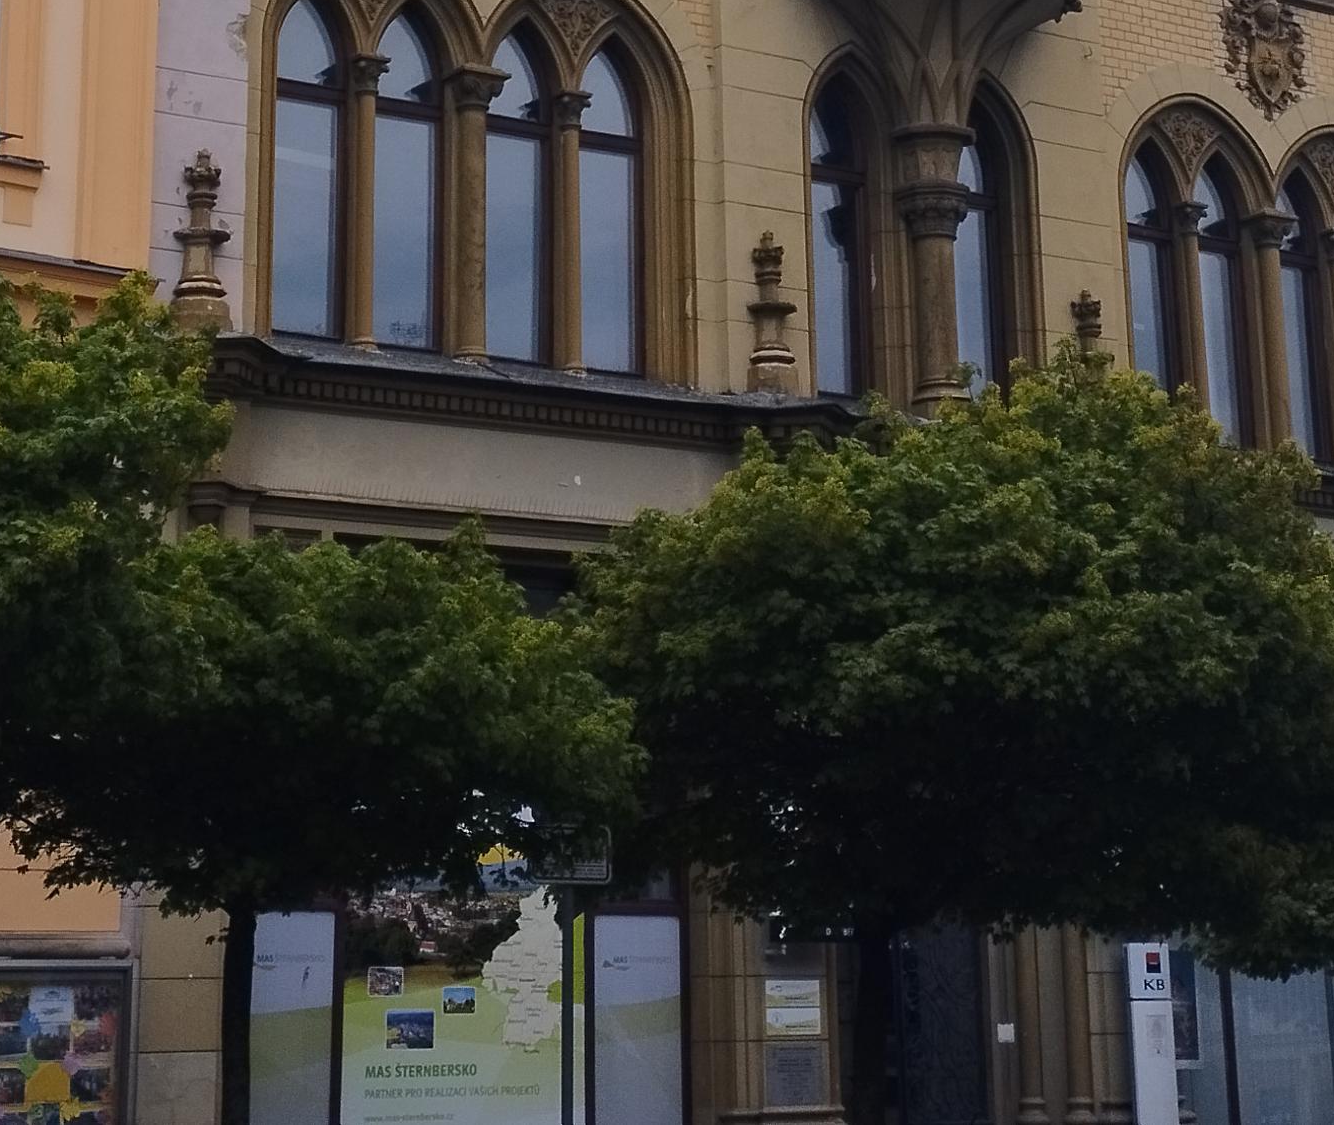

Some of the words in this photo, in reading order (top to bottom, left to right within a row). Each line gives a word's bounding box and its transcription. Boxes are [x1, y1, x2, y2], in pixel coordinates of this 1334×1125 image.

[1143, 978, 1165, 991] KB
[365, 1065, 392, 1079] MAS
[395, 1062, 478, 1078] ŠTERNBERSKO
[364, 1088, 403, 1099] PARTNER
[405, 1088, 423, 1098] PRO
